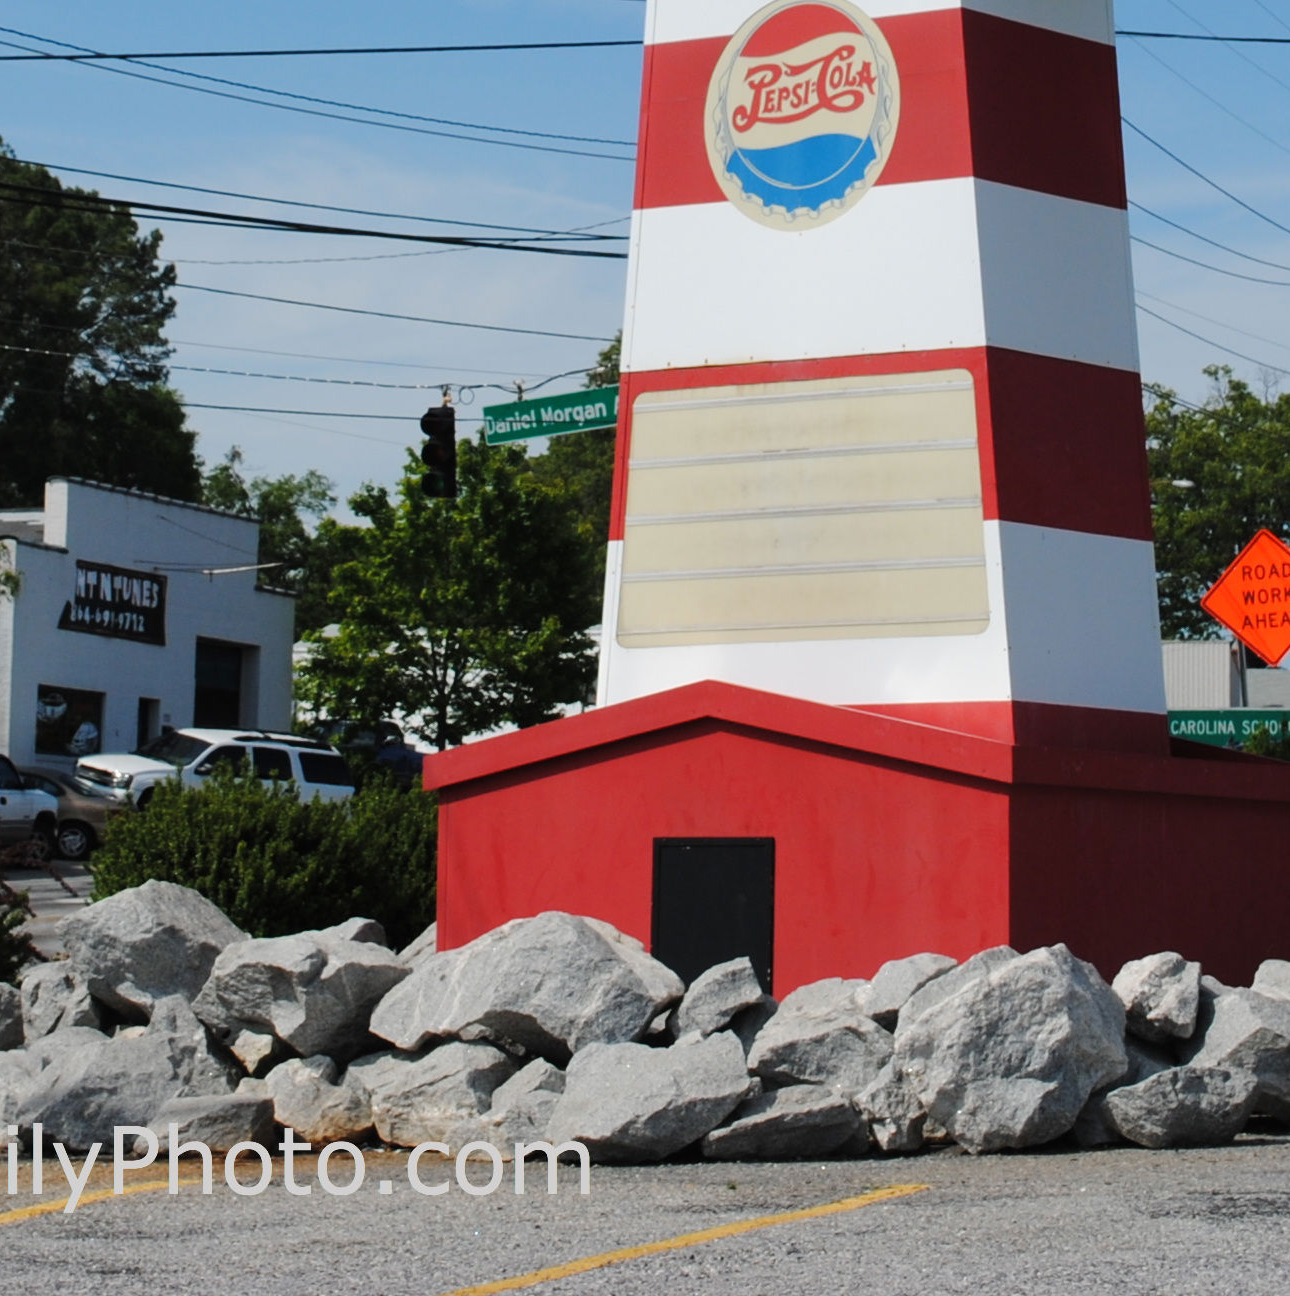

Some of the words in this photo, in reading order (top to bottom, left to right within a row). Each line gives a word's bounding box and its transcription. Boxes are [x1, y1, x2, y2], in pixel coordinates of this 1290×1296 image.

[485, 409, 537, 436] Daniel
[540, 401, 607, 427] Morgan
[1170, 720, 1235, 735] CAROLINA
